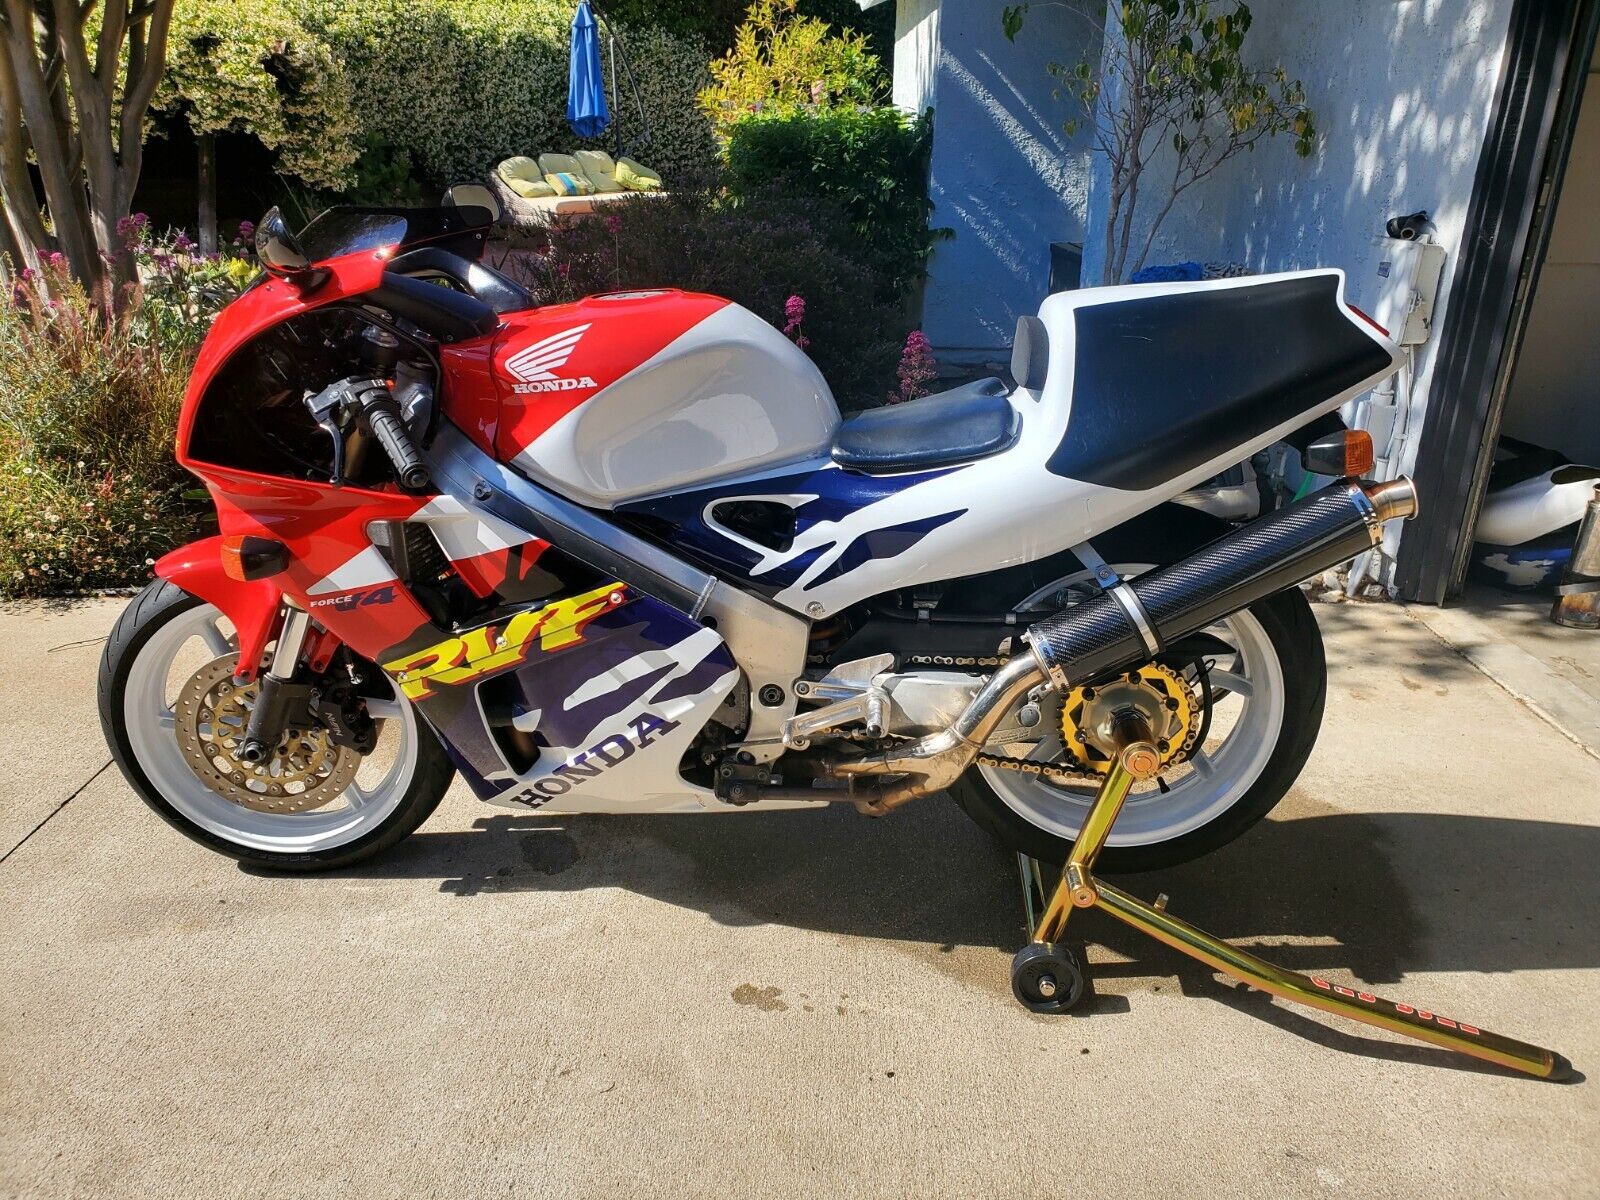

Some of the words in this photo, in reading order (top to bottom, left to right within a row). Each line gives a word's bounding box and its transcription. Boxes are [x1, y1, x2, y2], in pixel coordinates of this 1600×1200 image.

[511, 376, 598, 394] HONDA
[309, 594, 353, 608] FORCE
[382, 581, 628, 703] RVF
[509, 711, 682, 809] HONDA
